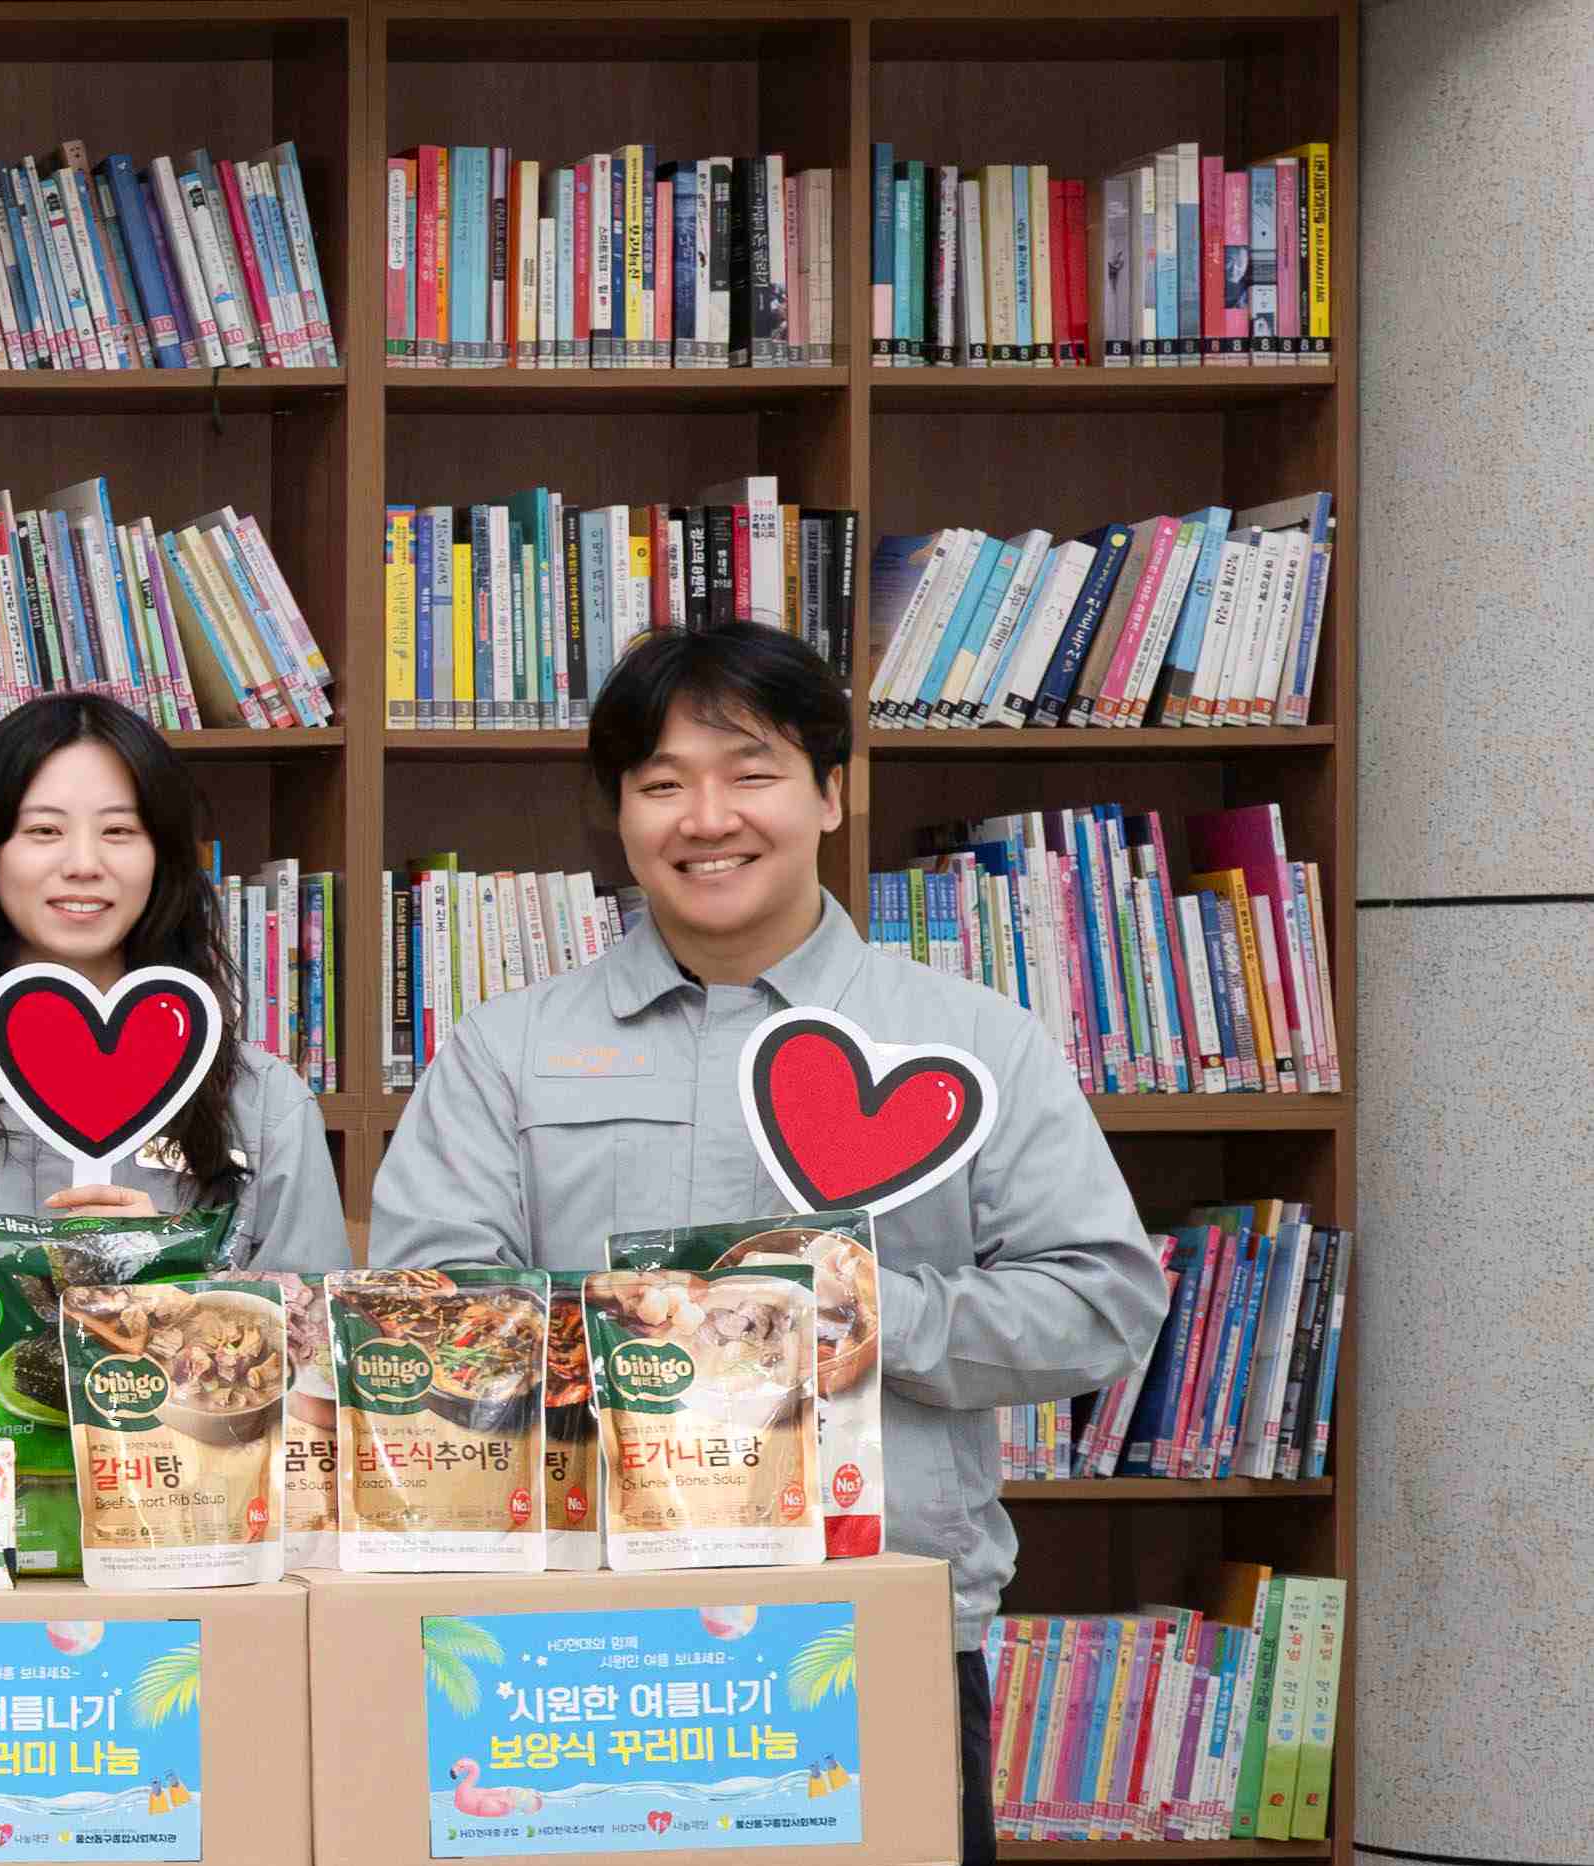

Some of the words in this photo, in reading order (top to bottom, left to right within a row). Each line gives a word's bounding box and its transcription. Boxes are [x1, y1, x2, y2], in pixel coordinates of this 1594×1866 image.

[356, 1355, 429, 1383] bibigo
[615, 1354, 692, 1381] bibigo
[93, 1372, 166, 1400] bibigo
[355, 1441, 512, 1472] 남도식추어탕
[620, 1438, 763, 1469] 도가니곰탕
[91, 1454, 183, 1491] 갈비탕
[711, 1473, 746, 1488] Soup
[95, 1495, 126, 1509] Beef
[194, 1492, 226, 1507] Soup
[507, 1683, 619, 1725] 시원한
[629, 1677, 773, 1720] 여름나기
[488, 1730, 595, 1771] 보양식
[606, 1726, 714, 1767] 꾸러미
[727, 1723, 800, 1762] 나눔
